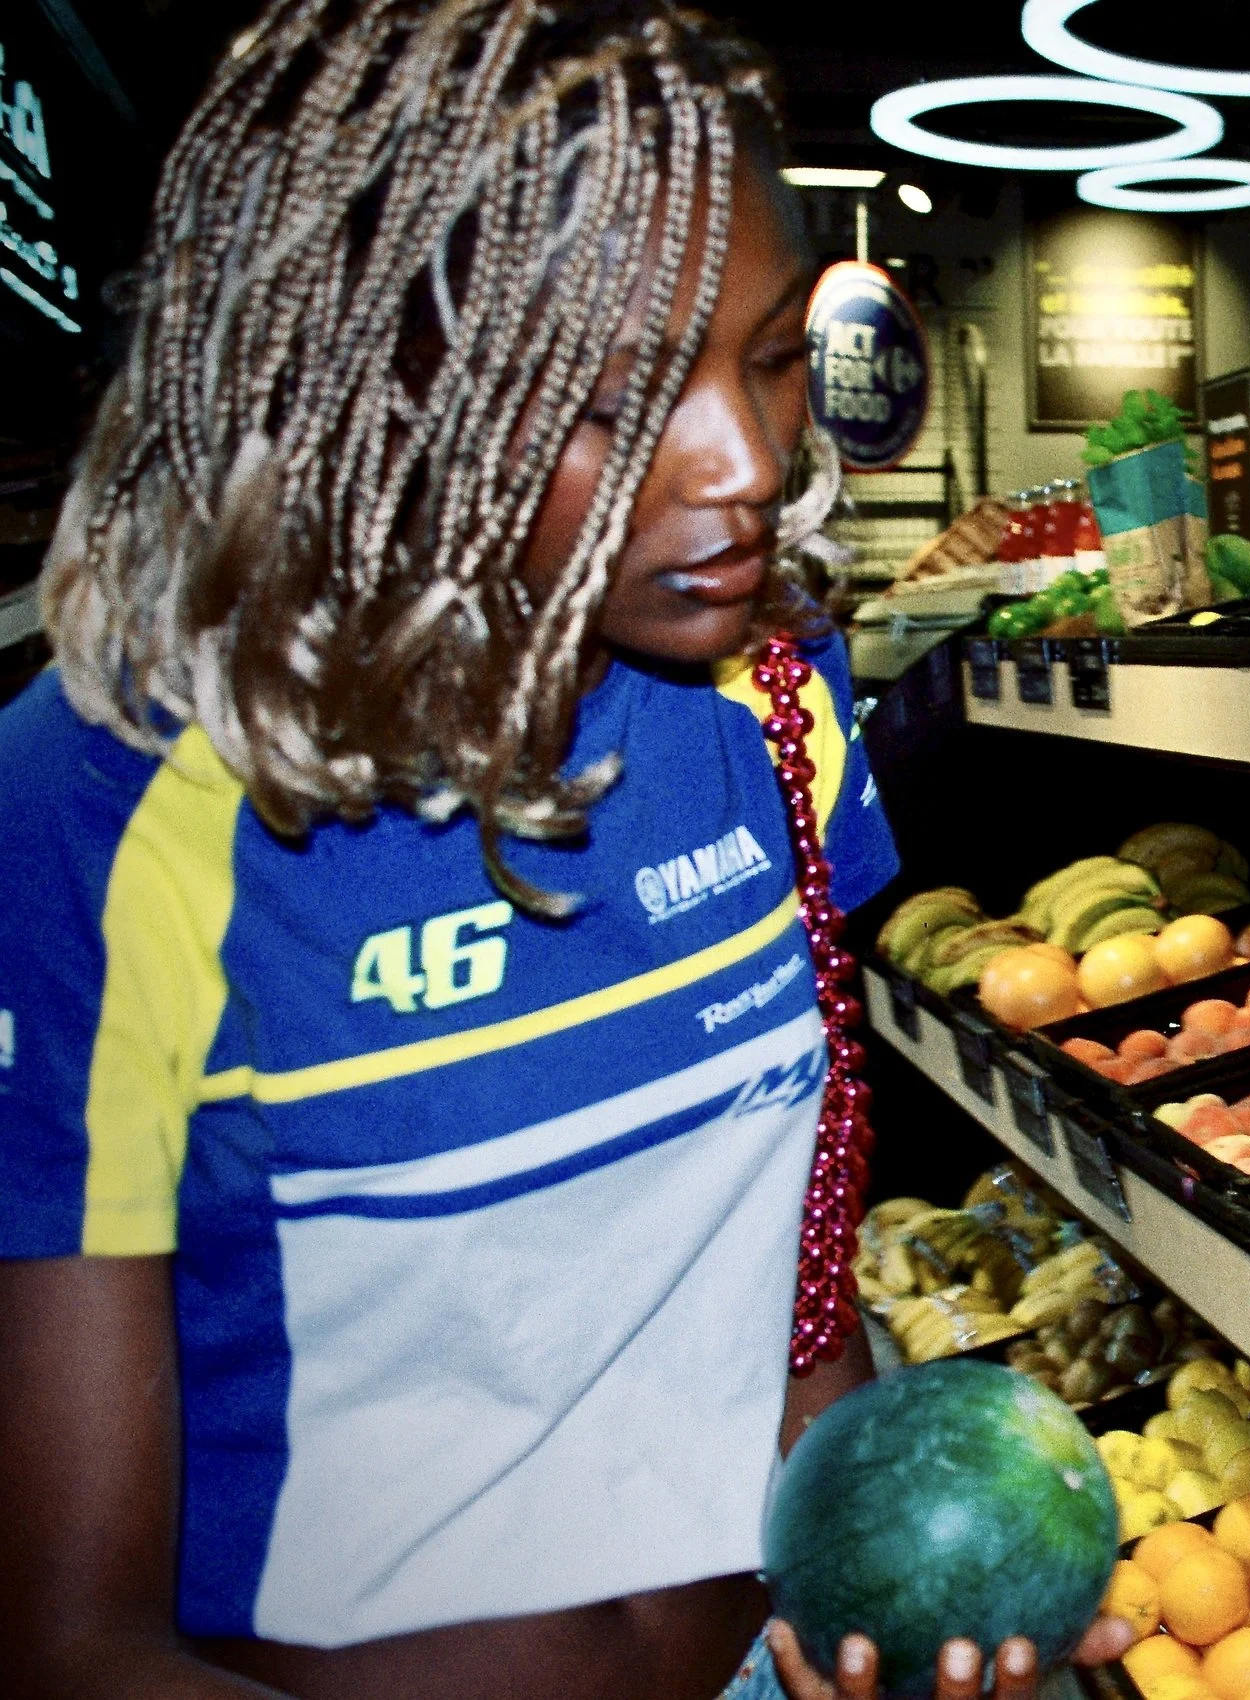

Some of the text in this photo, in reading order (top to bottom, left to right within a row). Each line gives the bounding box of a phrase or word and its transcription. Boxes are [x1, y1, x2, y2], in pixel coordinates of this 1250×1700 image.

[826, 320, 876, 358] ACT
[825, 355, 873, 390] FOR
[825, 387, 891, 422] FOOD
[658, 825, 766, 903] YAMAHA
[352, 900, 513, 1012] 46
